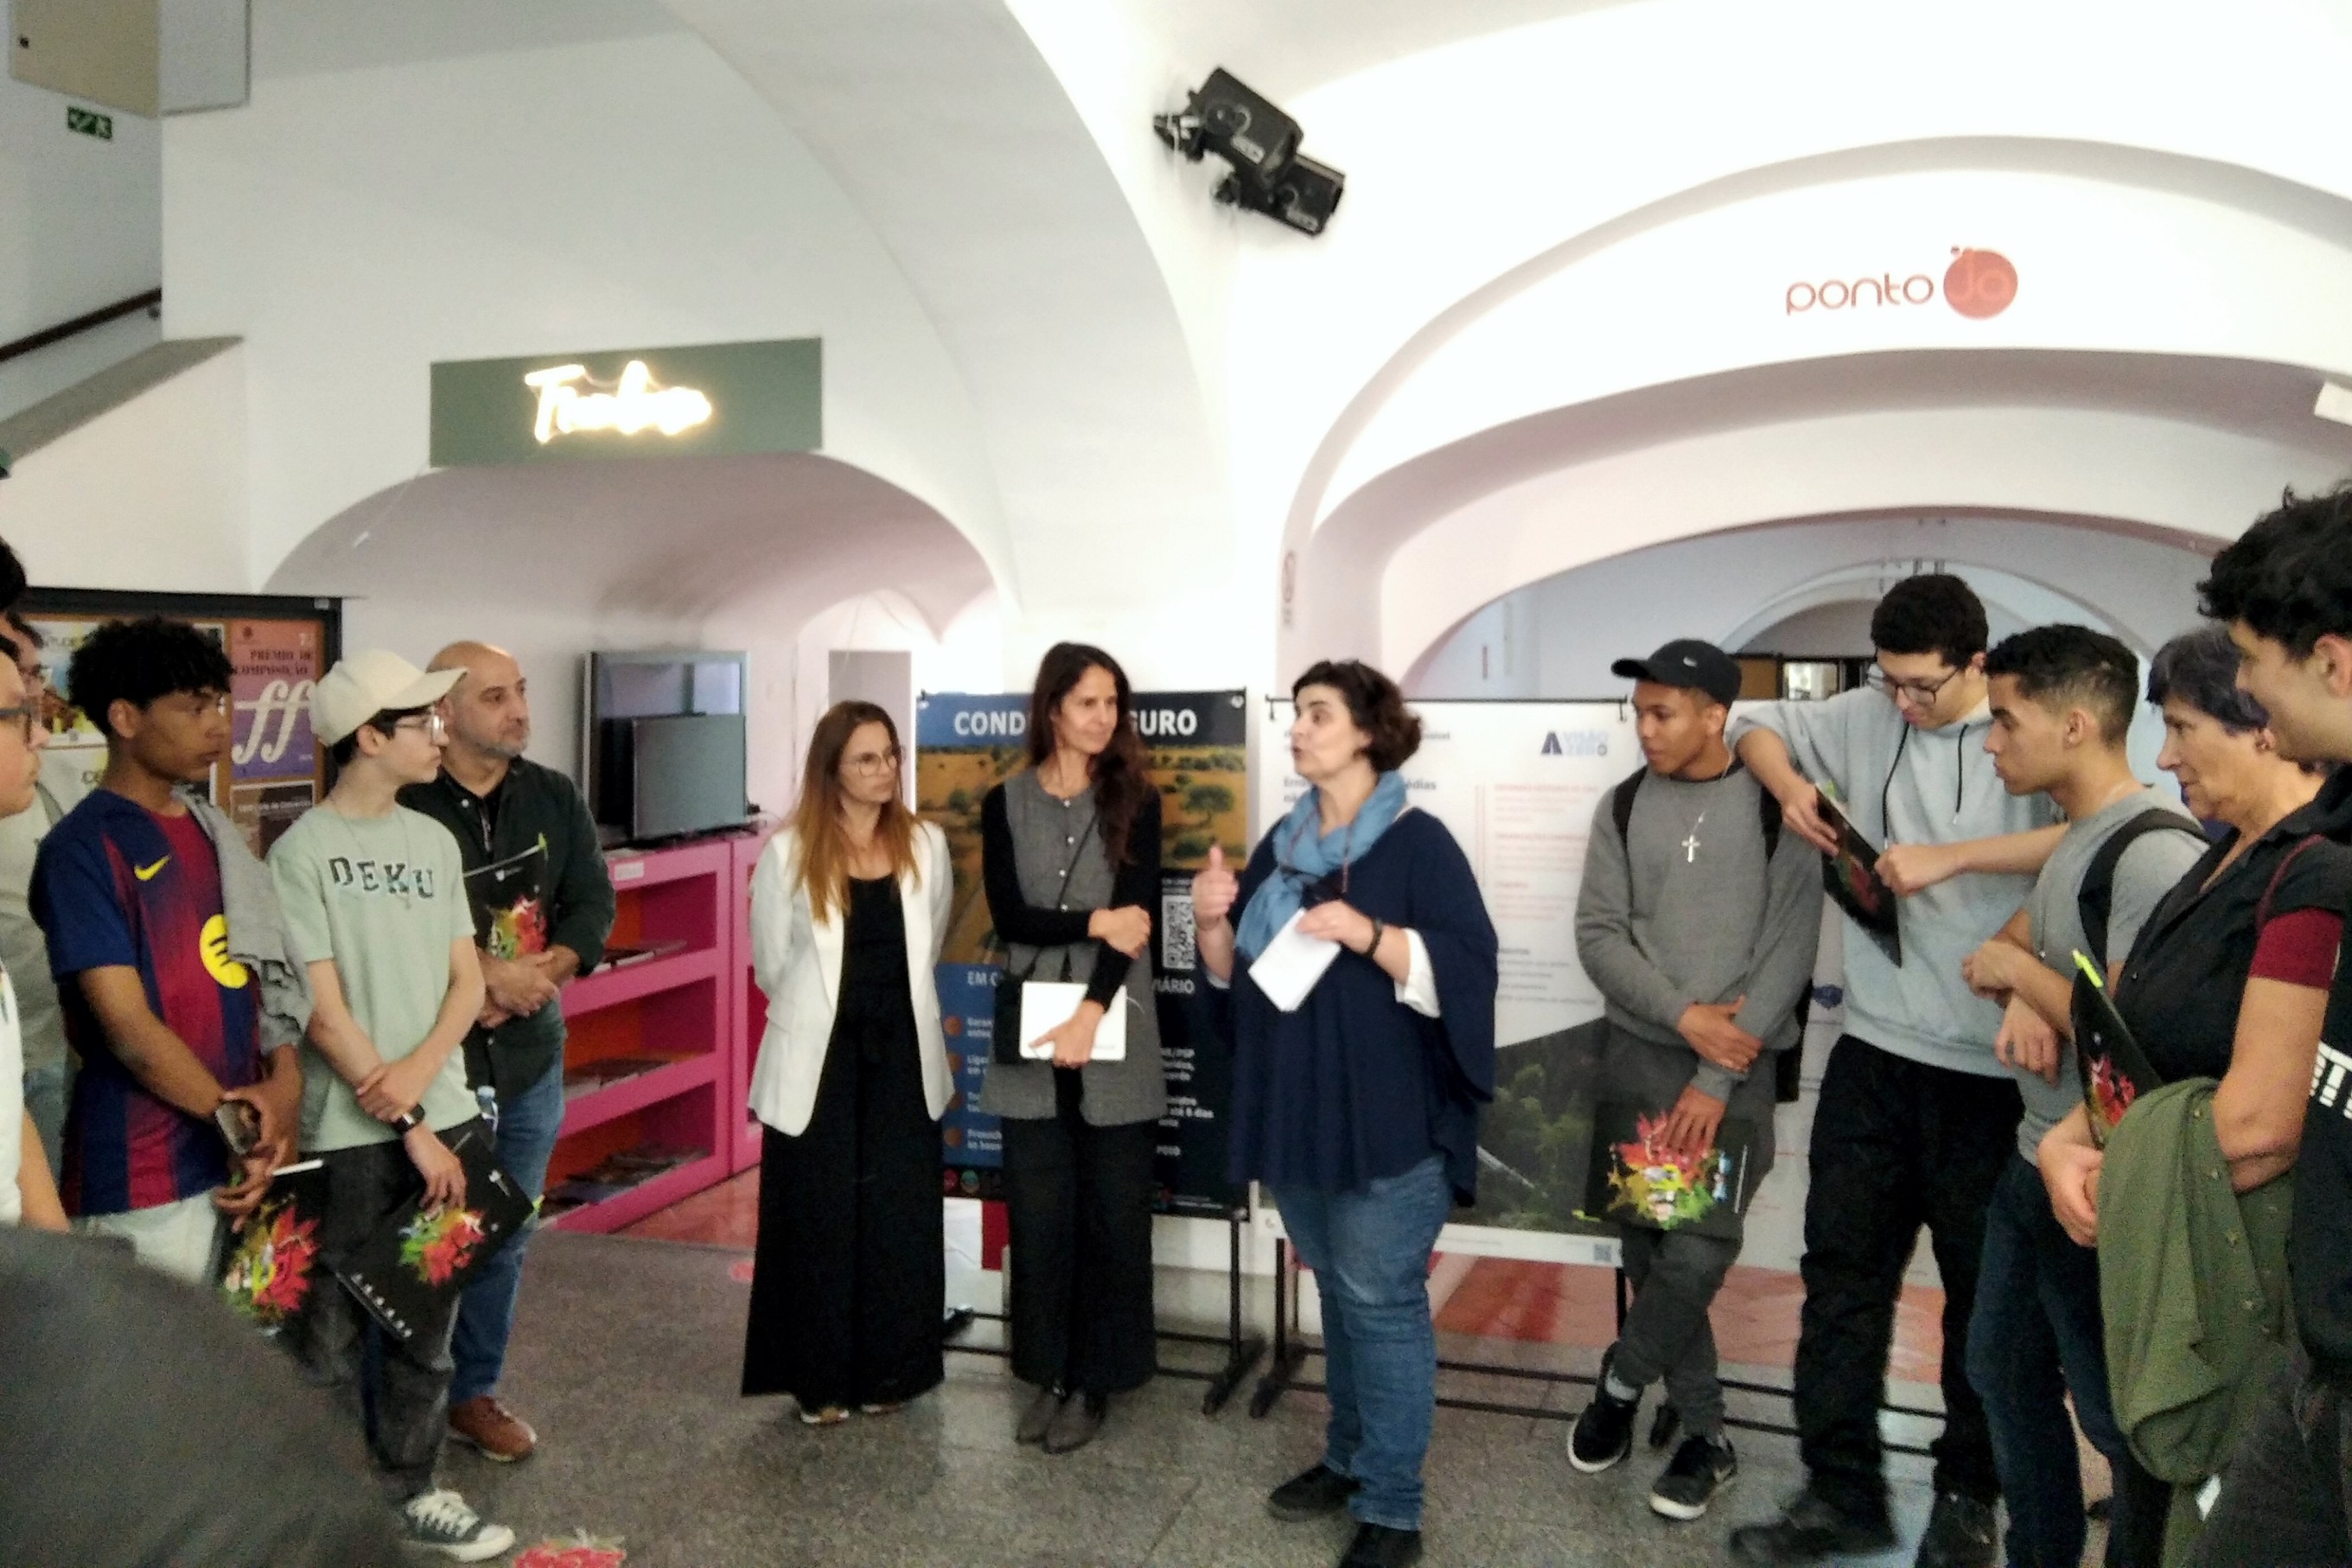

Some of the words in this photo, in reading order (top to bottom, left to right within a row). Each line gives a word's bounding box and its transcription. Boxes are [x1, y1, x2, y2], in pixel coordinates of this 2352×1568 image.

[1786, 272, 1935, 316] ponto
[954, 711, 1027, 736] COND
[328, 856, 434, 899] DEKU
